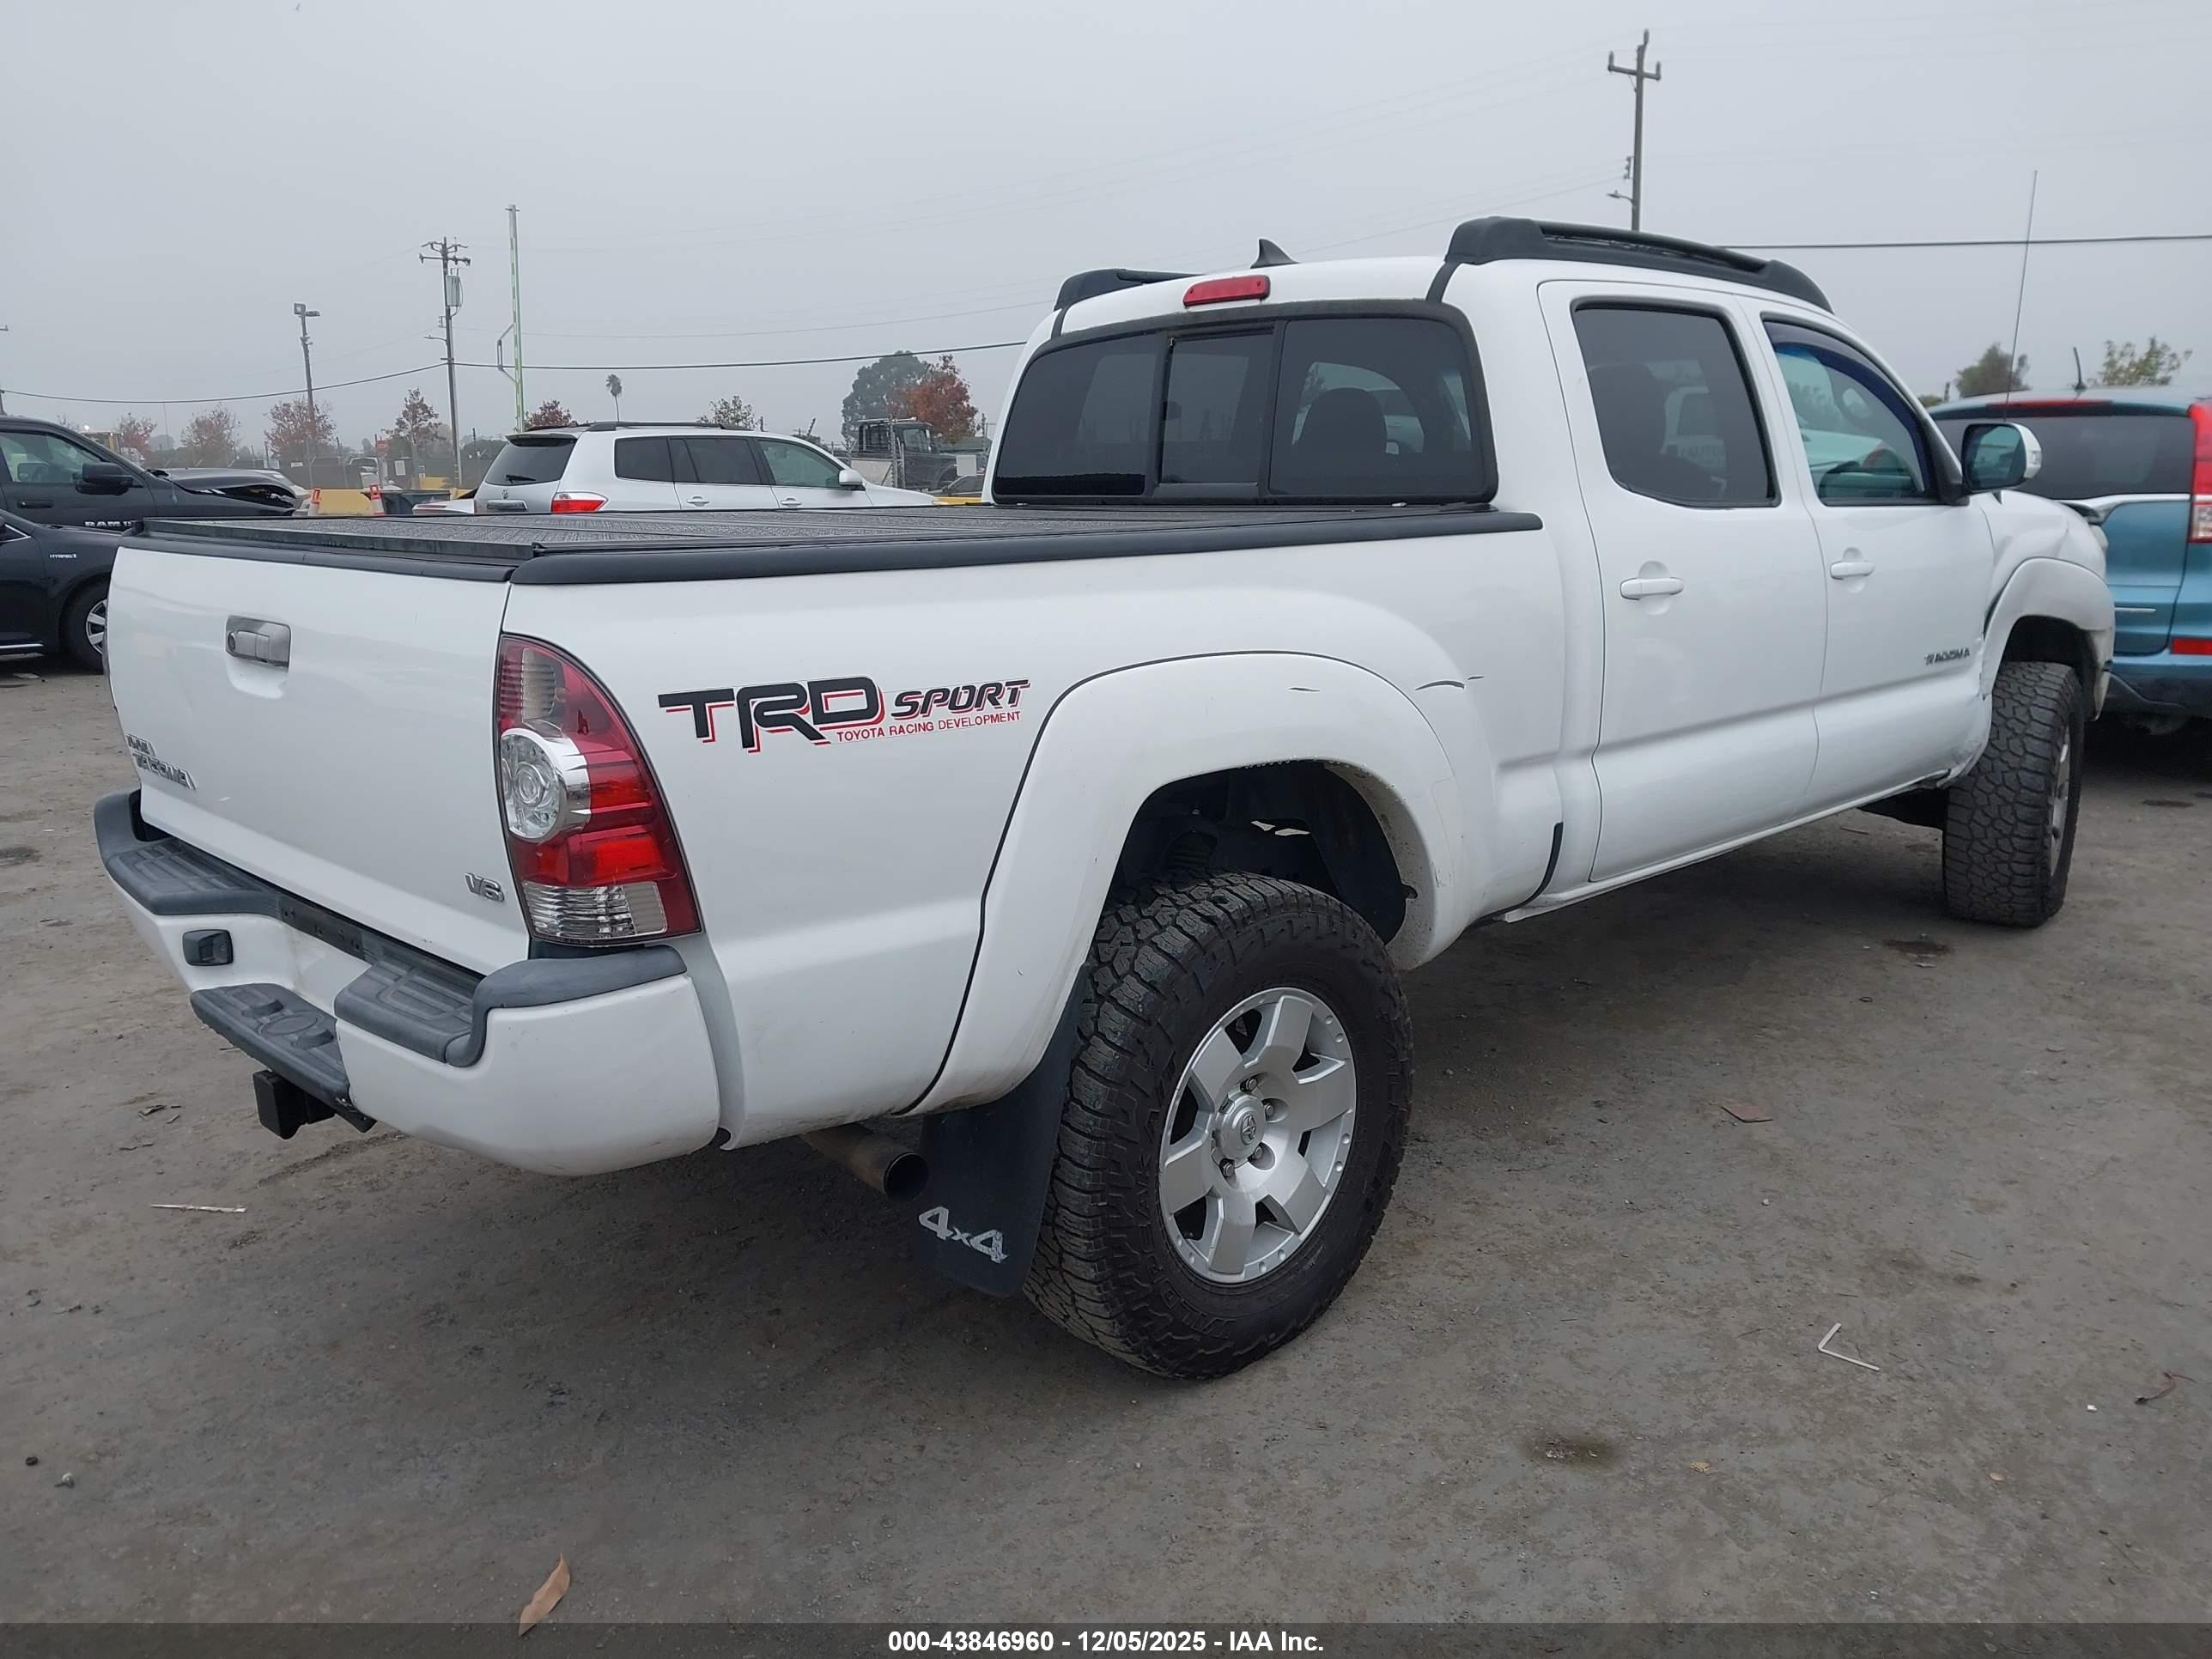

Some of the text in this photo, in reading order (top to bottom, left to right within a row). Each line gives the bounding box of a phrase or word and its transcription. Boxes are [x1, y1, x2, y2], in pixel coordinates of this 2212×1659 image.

[1924, 647, 1971, 665] TACOMA
[658, 677, 1031, 753] TRD SPORT
[836, 710, 1021, 743] TOYOTA RACING DEVELOPMENT
[464, 872, 505, 902] V6
